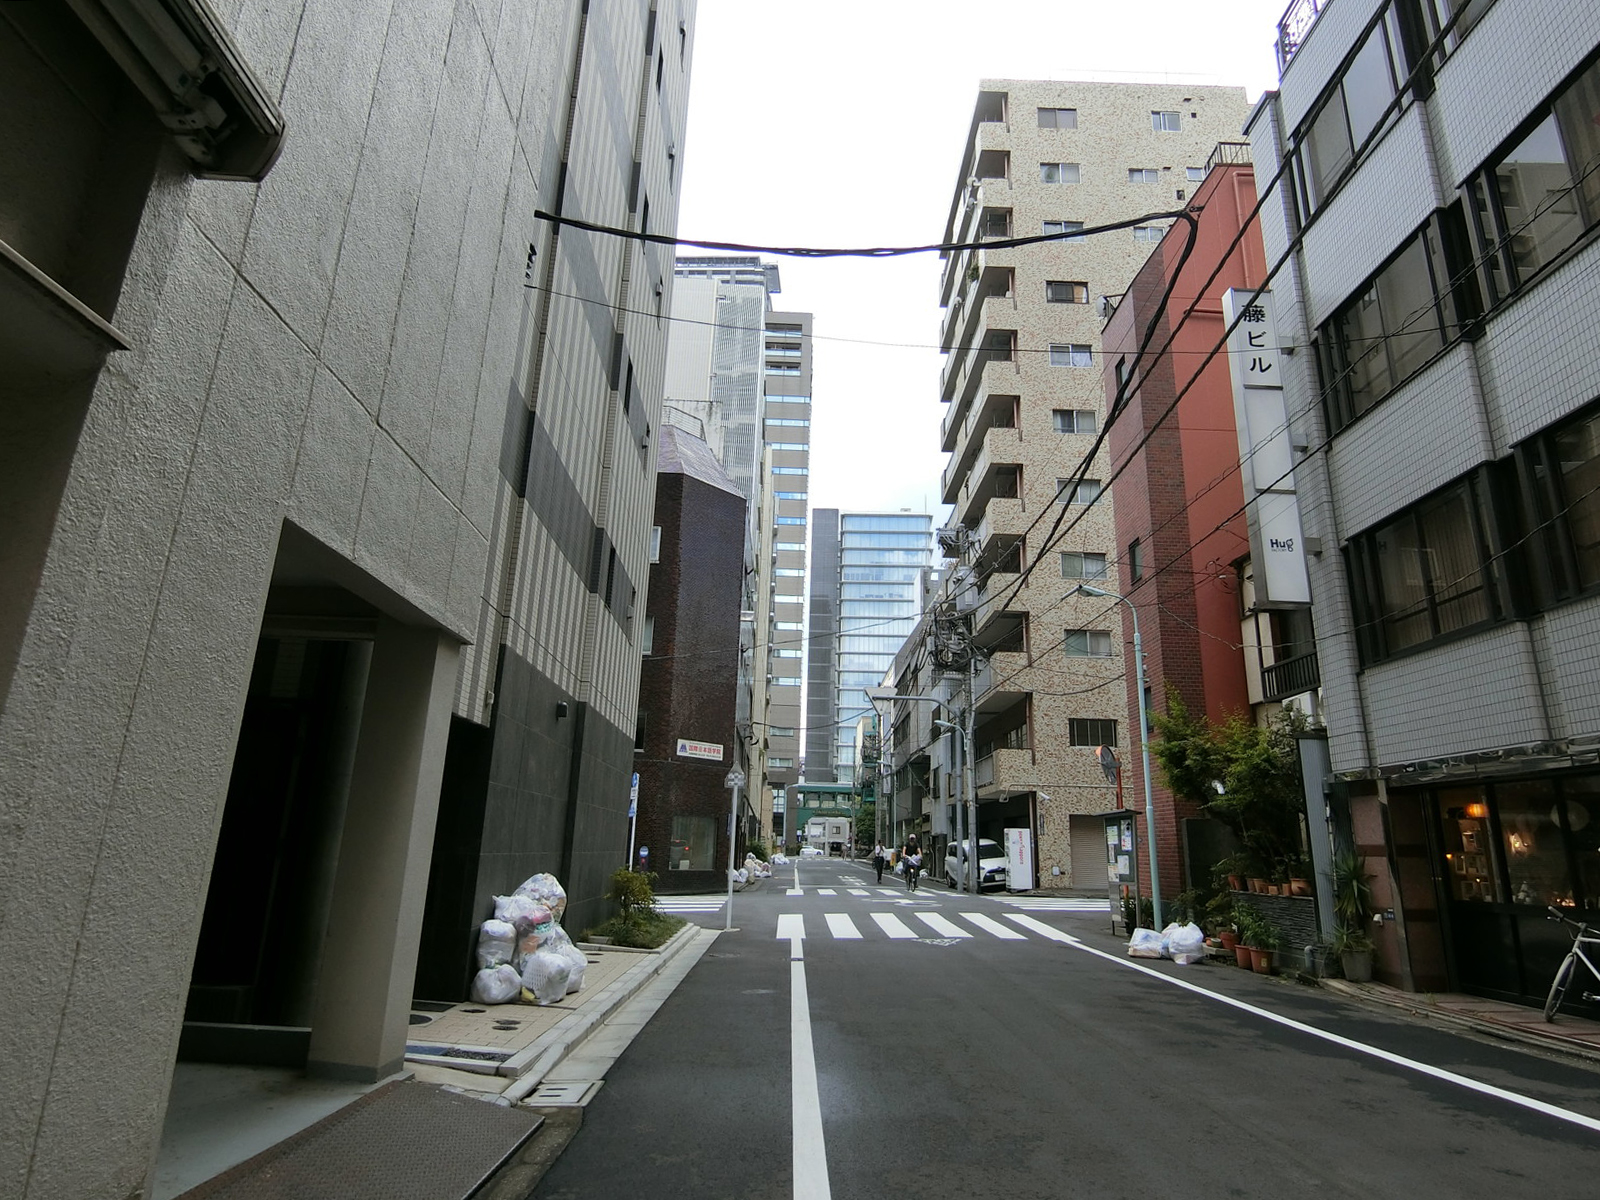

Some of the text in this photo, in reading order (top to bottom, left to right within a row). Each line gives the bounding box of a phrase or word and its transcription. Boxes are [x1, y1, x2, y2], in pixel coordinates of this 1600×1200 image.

[1241, 304, 1272, 373] 藤ビル
[1270, 538, 1294, 552] Hug
